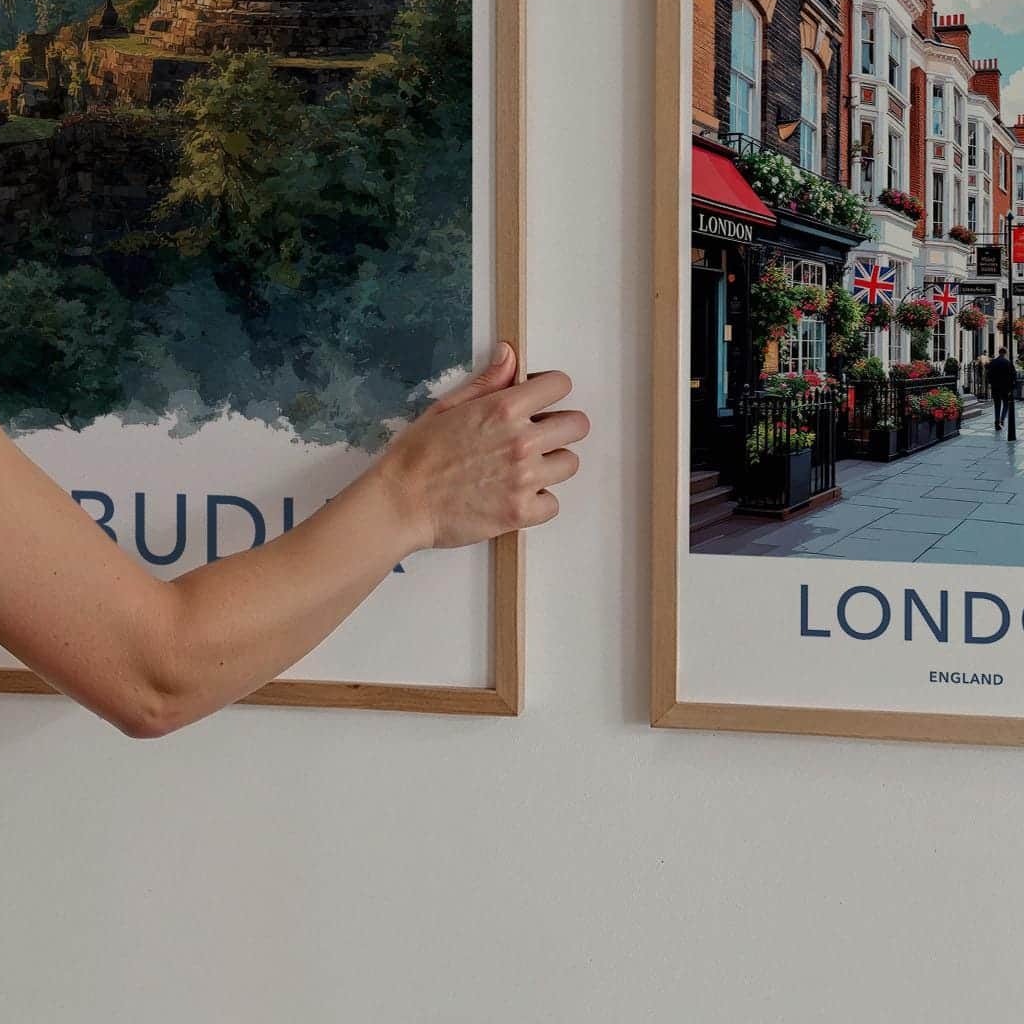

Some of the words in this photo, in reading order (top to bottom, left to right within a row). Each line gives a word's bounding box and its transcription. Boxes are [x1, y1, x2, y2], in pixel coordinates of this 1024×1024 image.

[698, 213, 753, 242] LONDON
[800, 584, 1024, 645] LOND
[928, 670, 1004, 686] ENGLAND
